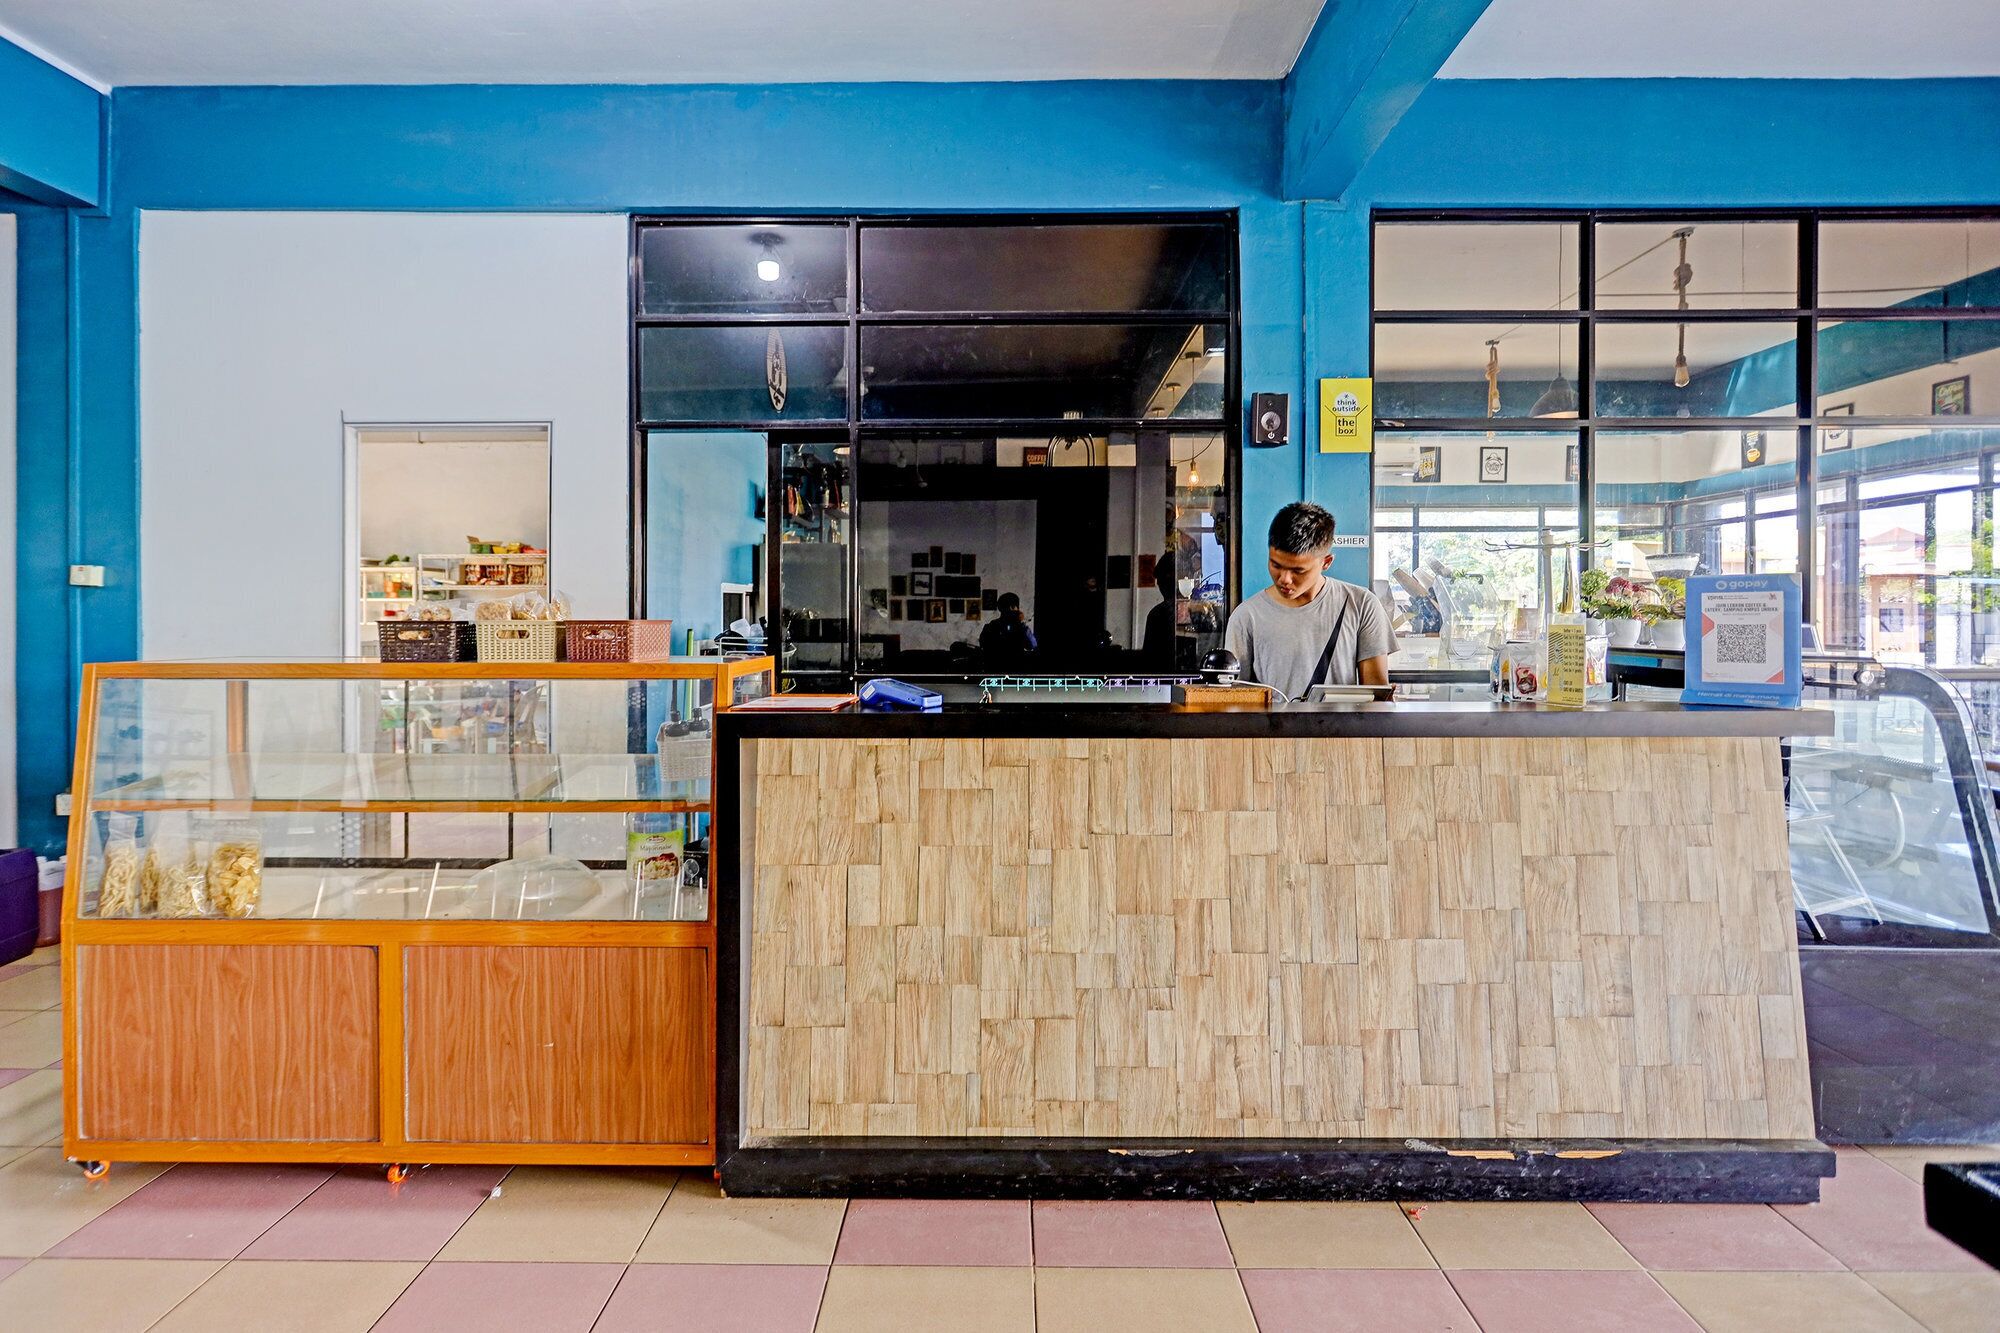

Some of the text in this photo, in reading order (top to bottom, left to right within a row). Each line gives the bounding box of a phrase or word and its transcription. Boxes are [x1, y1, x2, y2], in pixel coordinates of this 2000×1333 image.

[1337, 418, 1355, 427] the
[1333, 537, 1365, 545] ASHIER
[1729, 579, 1768, 590] gopay
